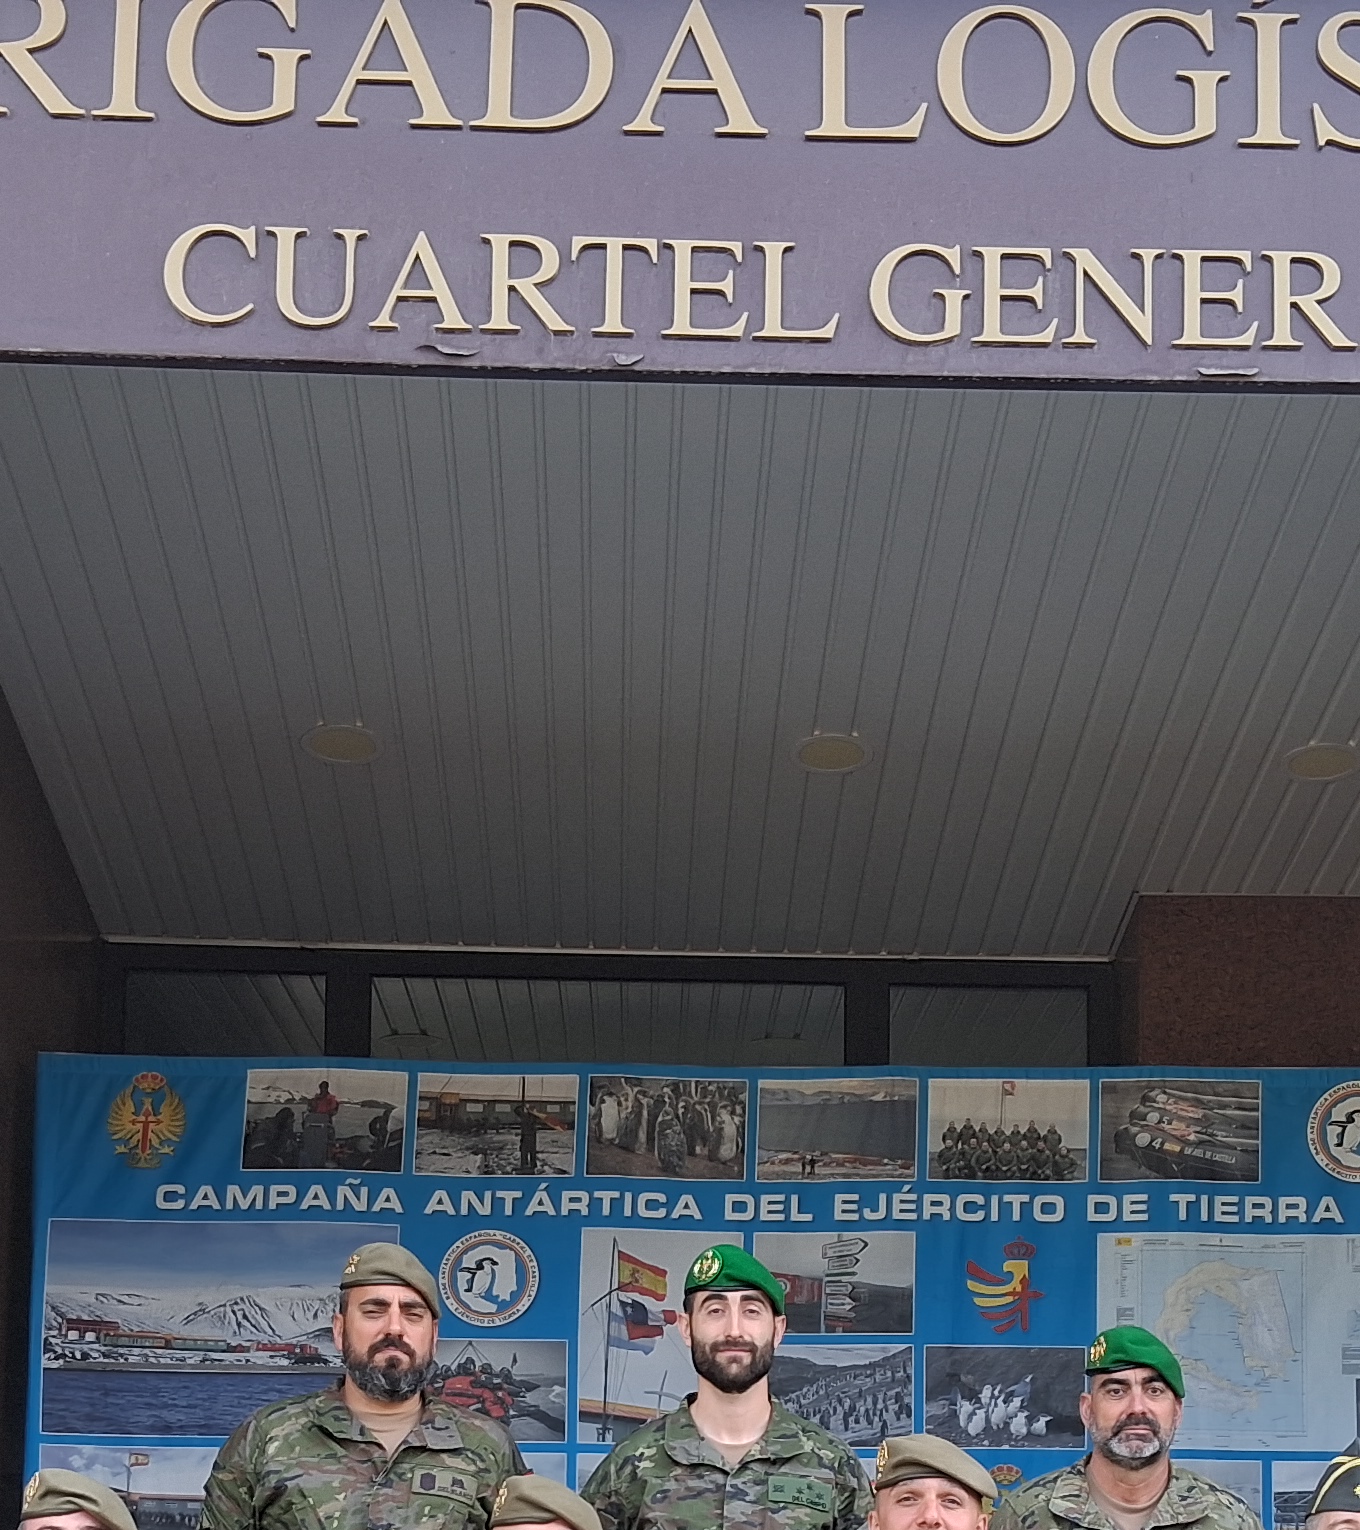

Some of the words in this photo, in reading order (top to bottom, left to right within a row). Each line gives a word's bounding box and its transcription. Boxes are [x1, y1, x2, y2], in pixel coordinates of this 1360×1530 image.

[163, 223, 840, 342] CUARTEL
[1151, 1138, 1163, 1150] 4
[155, 1178, 404, 1215] CAMPAÑA
[424, 1183, 704, 1221] ANTÁRTICA
[724, 1192, 814, 1222] DEL
[833, 1185, 1065, 1223] EJÉRCITO
[1086, 1193, 1150, 1223] DE
[1169, 1194, 1345, 1224] TIERRA
